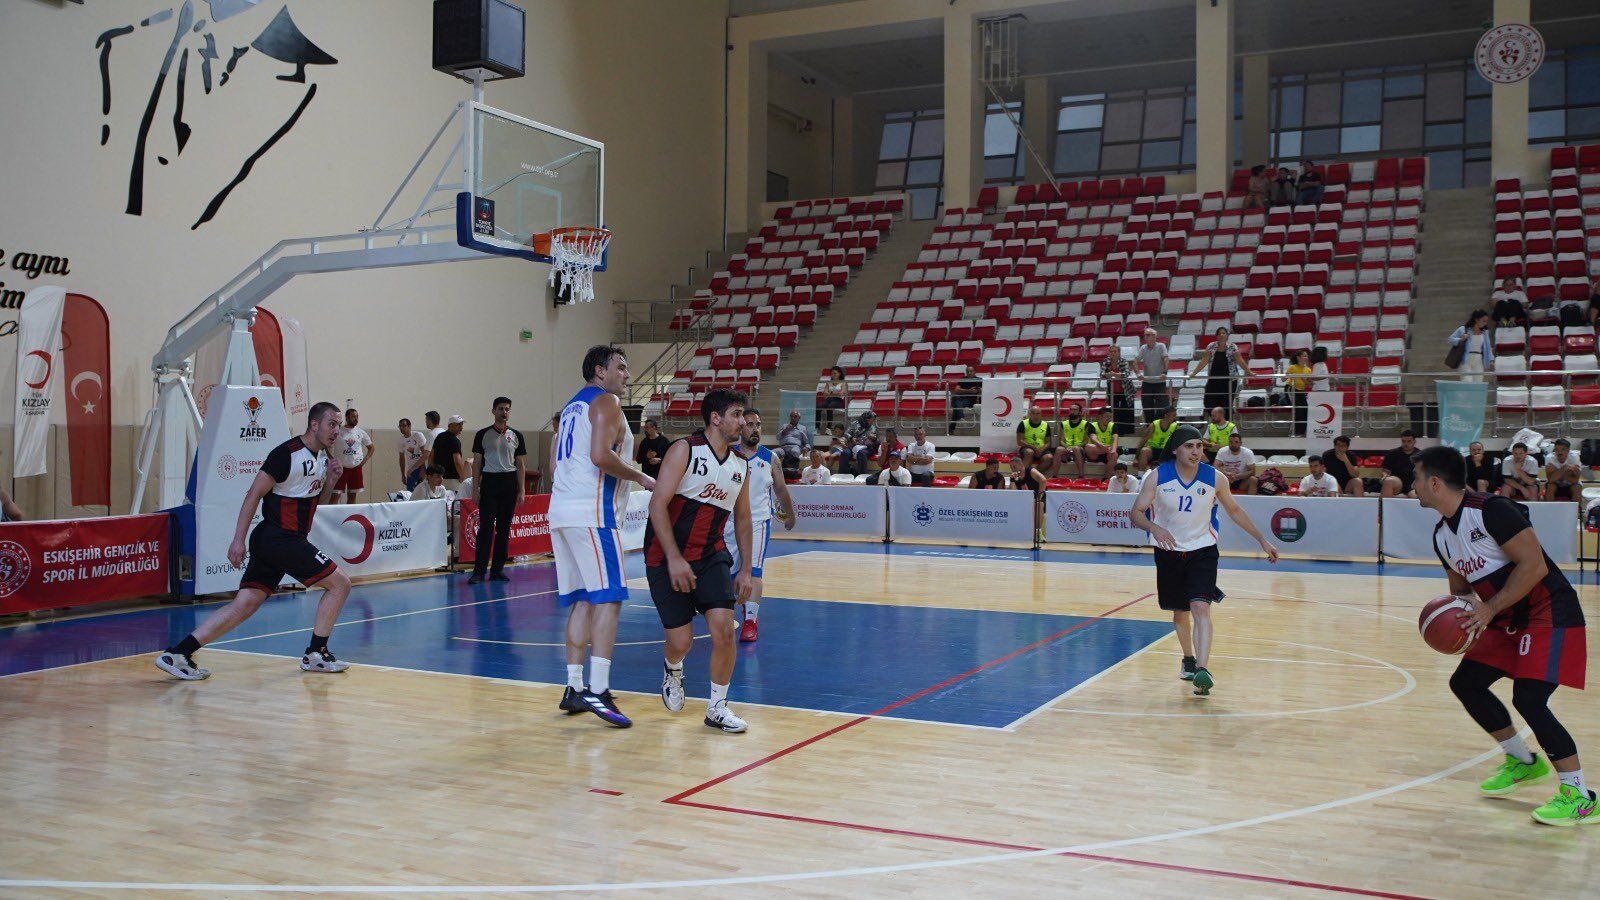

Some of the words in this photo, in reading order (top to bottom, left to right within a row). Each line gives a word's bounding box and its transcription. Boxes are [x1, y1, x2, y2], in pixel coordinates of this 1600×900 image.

[11, 252, 71, 280] aynı
[22, 398, 51, 408] KIZLAY
[240, 427, 267, 439] ZAFER
[557, 416, 576, 461] 18
[302, 459, 316, 477] 12
[692, 456, 709, 477] 13
[938, 507, 956, 516] ÖZEL
[956, 508, 993, 519] ESKİŞEHİR
[994, 510, 1009, 518] OSB
[1178, 495, 1193, 513] 12
[389, 520, 404, 528] TÜRK
[1096, 520, 1119, 529] SPOR
[1120, 519, 1128, 529] İL
[378, 527, 412, 541] KIZILAY
[43, 543, 102, 566] ESKİŞEHİR
[104, 540, 146, 559] GENÇLİK
[148, 540, 160, 553] VE
[381, 543, 409, 552] ESKİŞEHİR
[42, 569, 75, 584] SPOR
[78, 564, 89, 580] İL
[91, 554, 160, 579] MÜDÜRLÜĞÜ
[1455, 555, 1487, 579] Baro
[1519, 633, 1532, 656] 0
